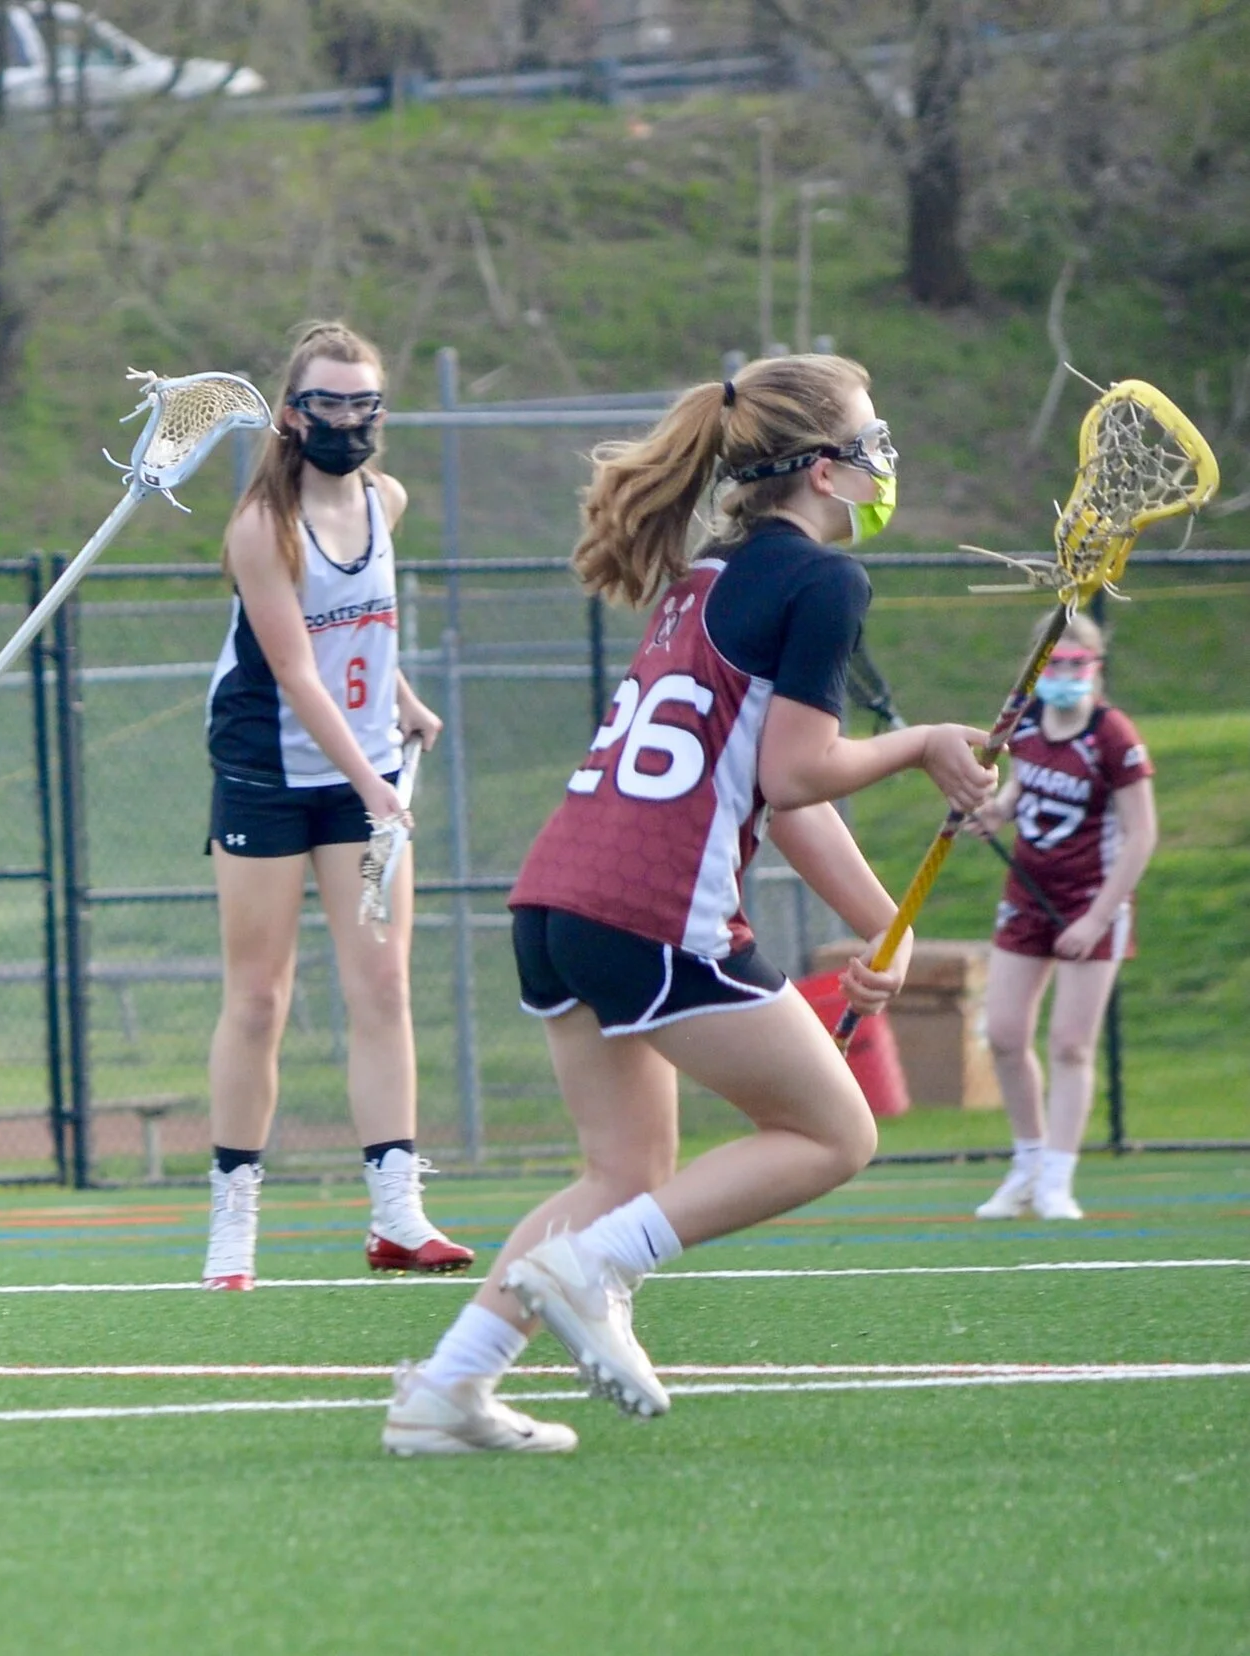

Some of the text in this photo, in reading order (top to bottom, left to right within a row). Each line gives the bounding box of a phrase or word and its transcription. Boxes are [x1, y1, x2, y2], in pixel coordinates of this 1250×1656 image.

[304, 596, 395, 629] COATESV
[346, 656, 367, 710] 6
[567, 673, 715, 801] 26
